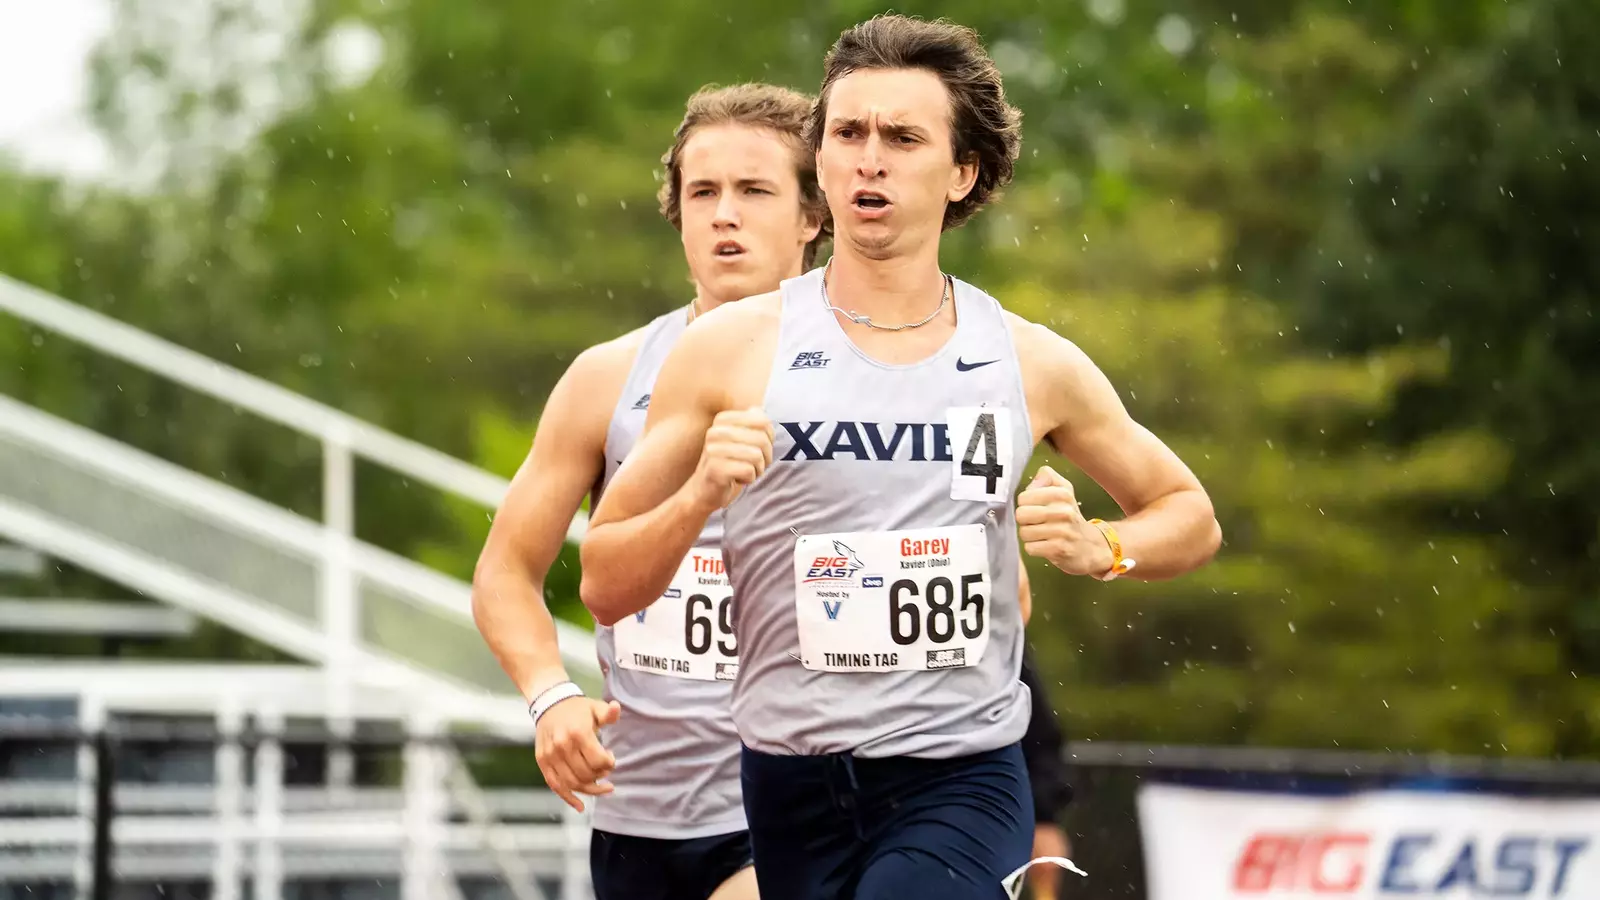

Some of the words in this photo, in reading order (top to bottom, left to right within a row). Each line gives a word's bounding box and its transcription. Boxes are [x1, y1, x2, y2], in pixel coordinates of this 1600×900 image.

[791, 359, 831, 367] EAST
[796, 351, 823, 360] BIG
[779, 421, 953, 461] XAVIE
[961, 413, 1003, 494] 4
[900, 538, 949, 557] Garey
[693, 556, 725, 575] Trip
[812, 557, 848, 567] BIG
[900, 561, 925, 569] Xavier
[806, 568, 858, 577] EAST
[889, 573, 984, 645] 685
[685, 594, 738, 657] 69
[633, 653, 668, 670] TIMING
[671, 659, 690, 673] TAG
[824, 652, 870, 667] TIMING
[875, 652, 898, 666] TAG
[1234, 832, 1371, 894] BIG
[1379, 833, 1592, 897] EAST
